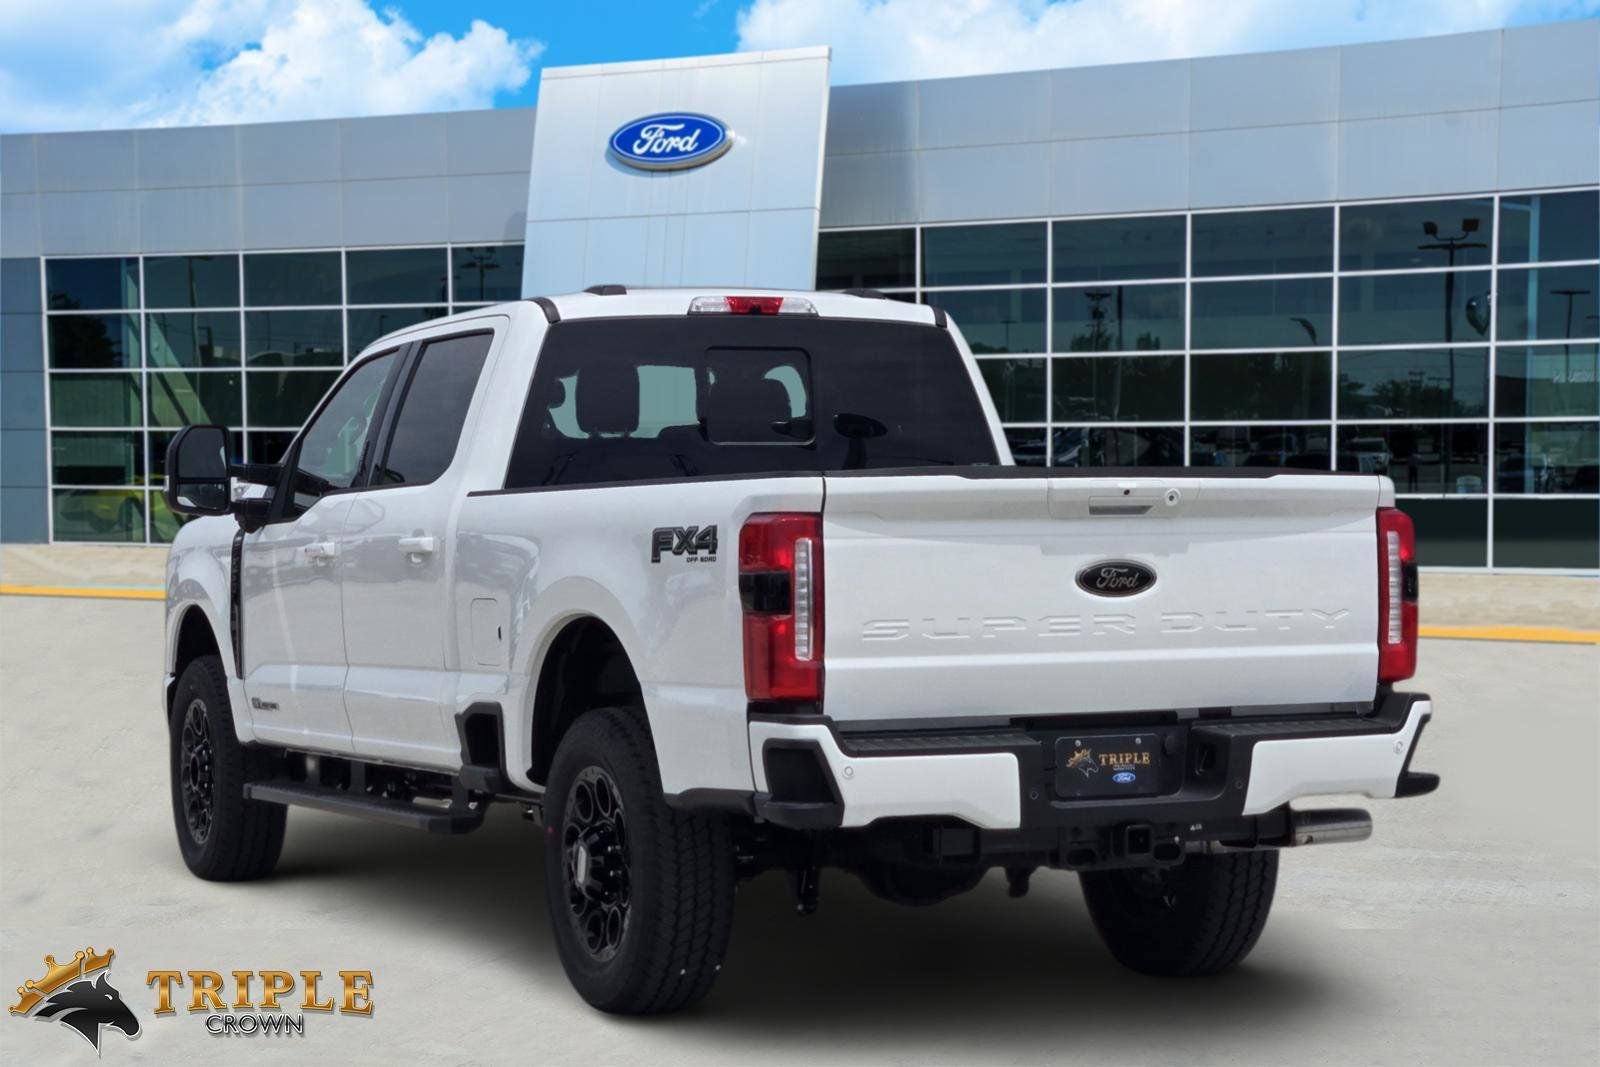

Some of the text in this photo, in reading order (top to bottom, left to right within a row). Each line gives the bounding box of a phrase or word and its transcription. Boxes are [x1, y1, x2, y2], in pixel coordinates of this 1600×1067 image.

[633, 124, 701, 154] Ford
[651, 525, 718, 563] FX4
[1096, 567, 1140, 588] Ford
[862, 608, 1350, 641] SUPER DUTY
[1098, 752, 1151, 766] TRIPLE
